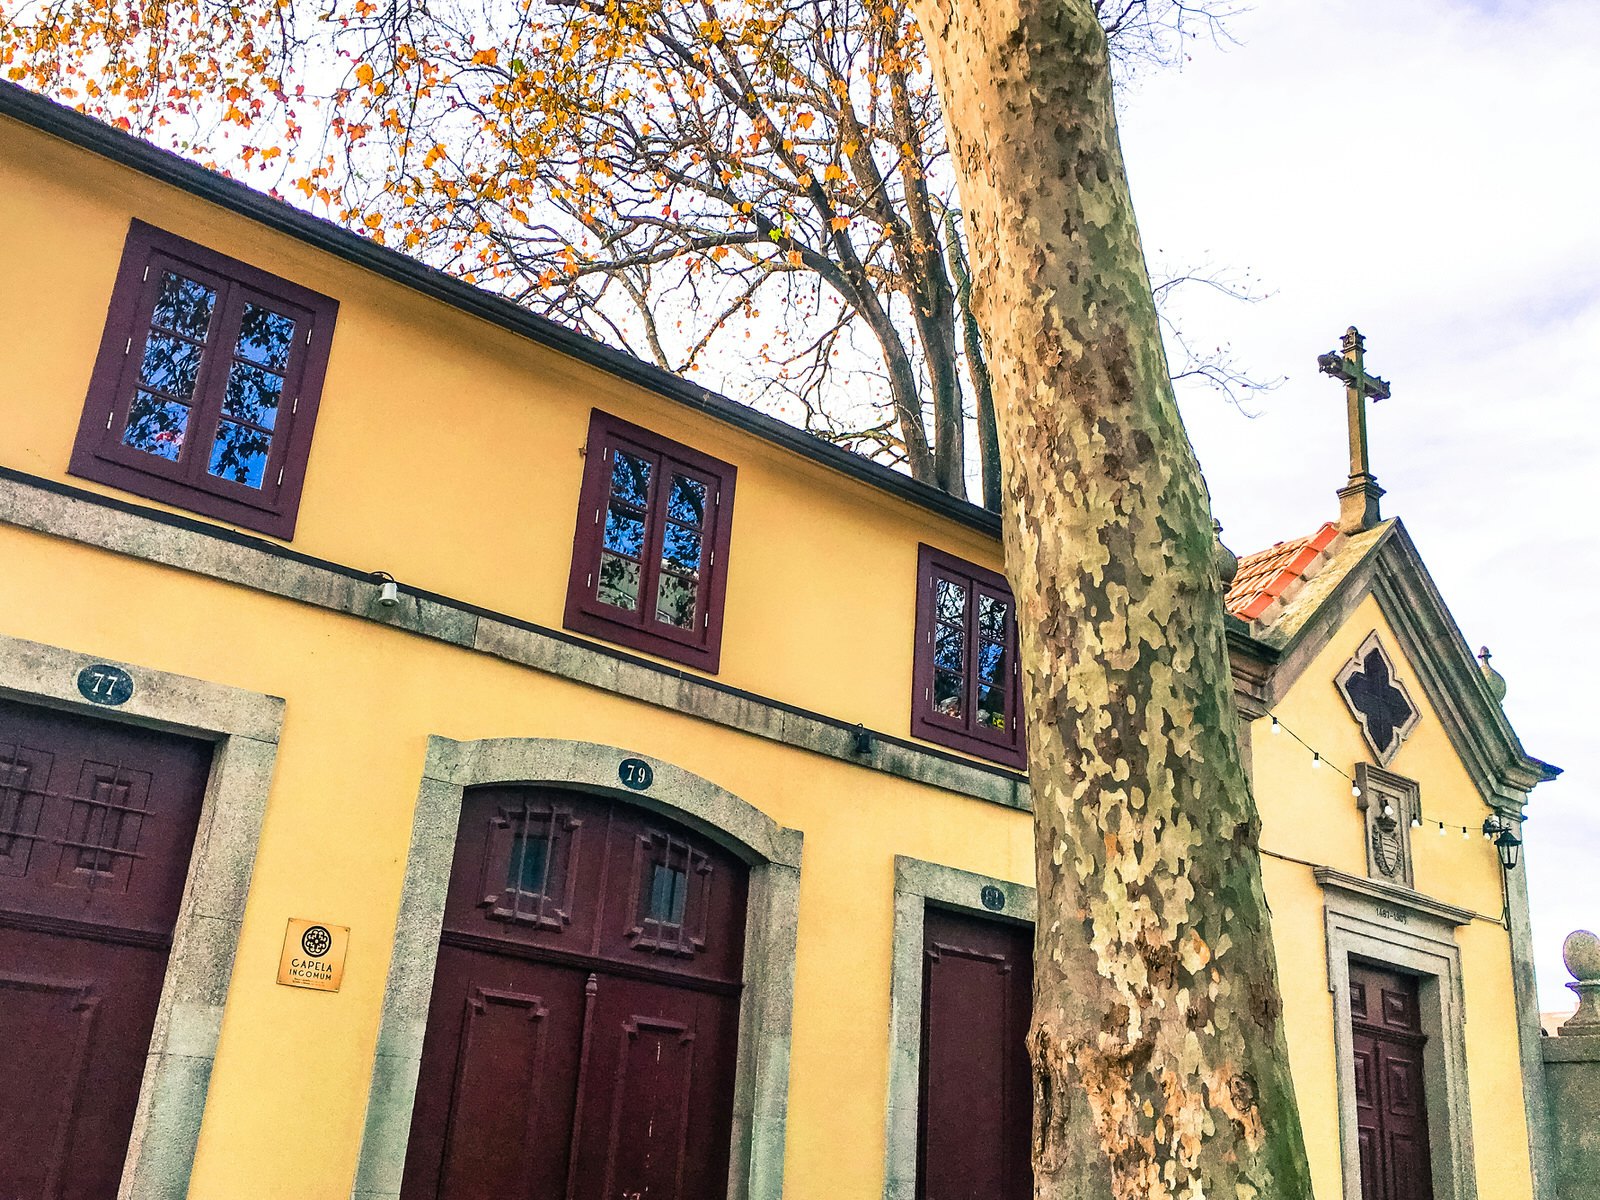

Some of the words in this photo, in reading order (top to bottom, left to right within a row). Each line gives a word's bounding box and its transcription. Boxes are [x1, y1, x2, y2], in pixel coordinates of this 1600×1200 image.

[92, 672, 118, 696] 77
[626, 764, 646, 784] 79
[291, 958, 332, 973] CAPELA
[289, 968, 332, 981] INCOMUM
